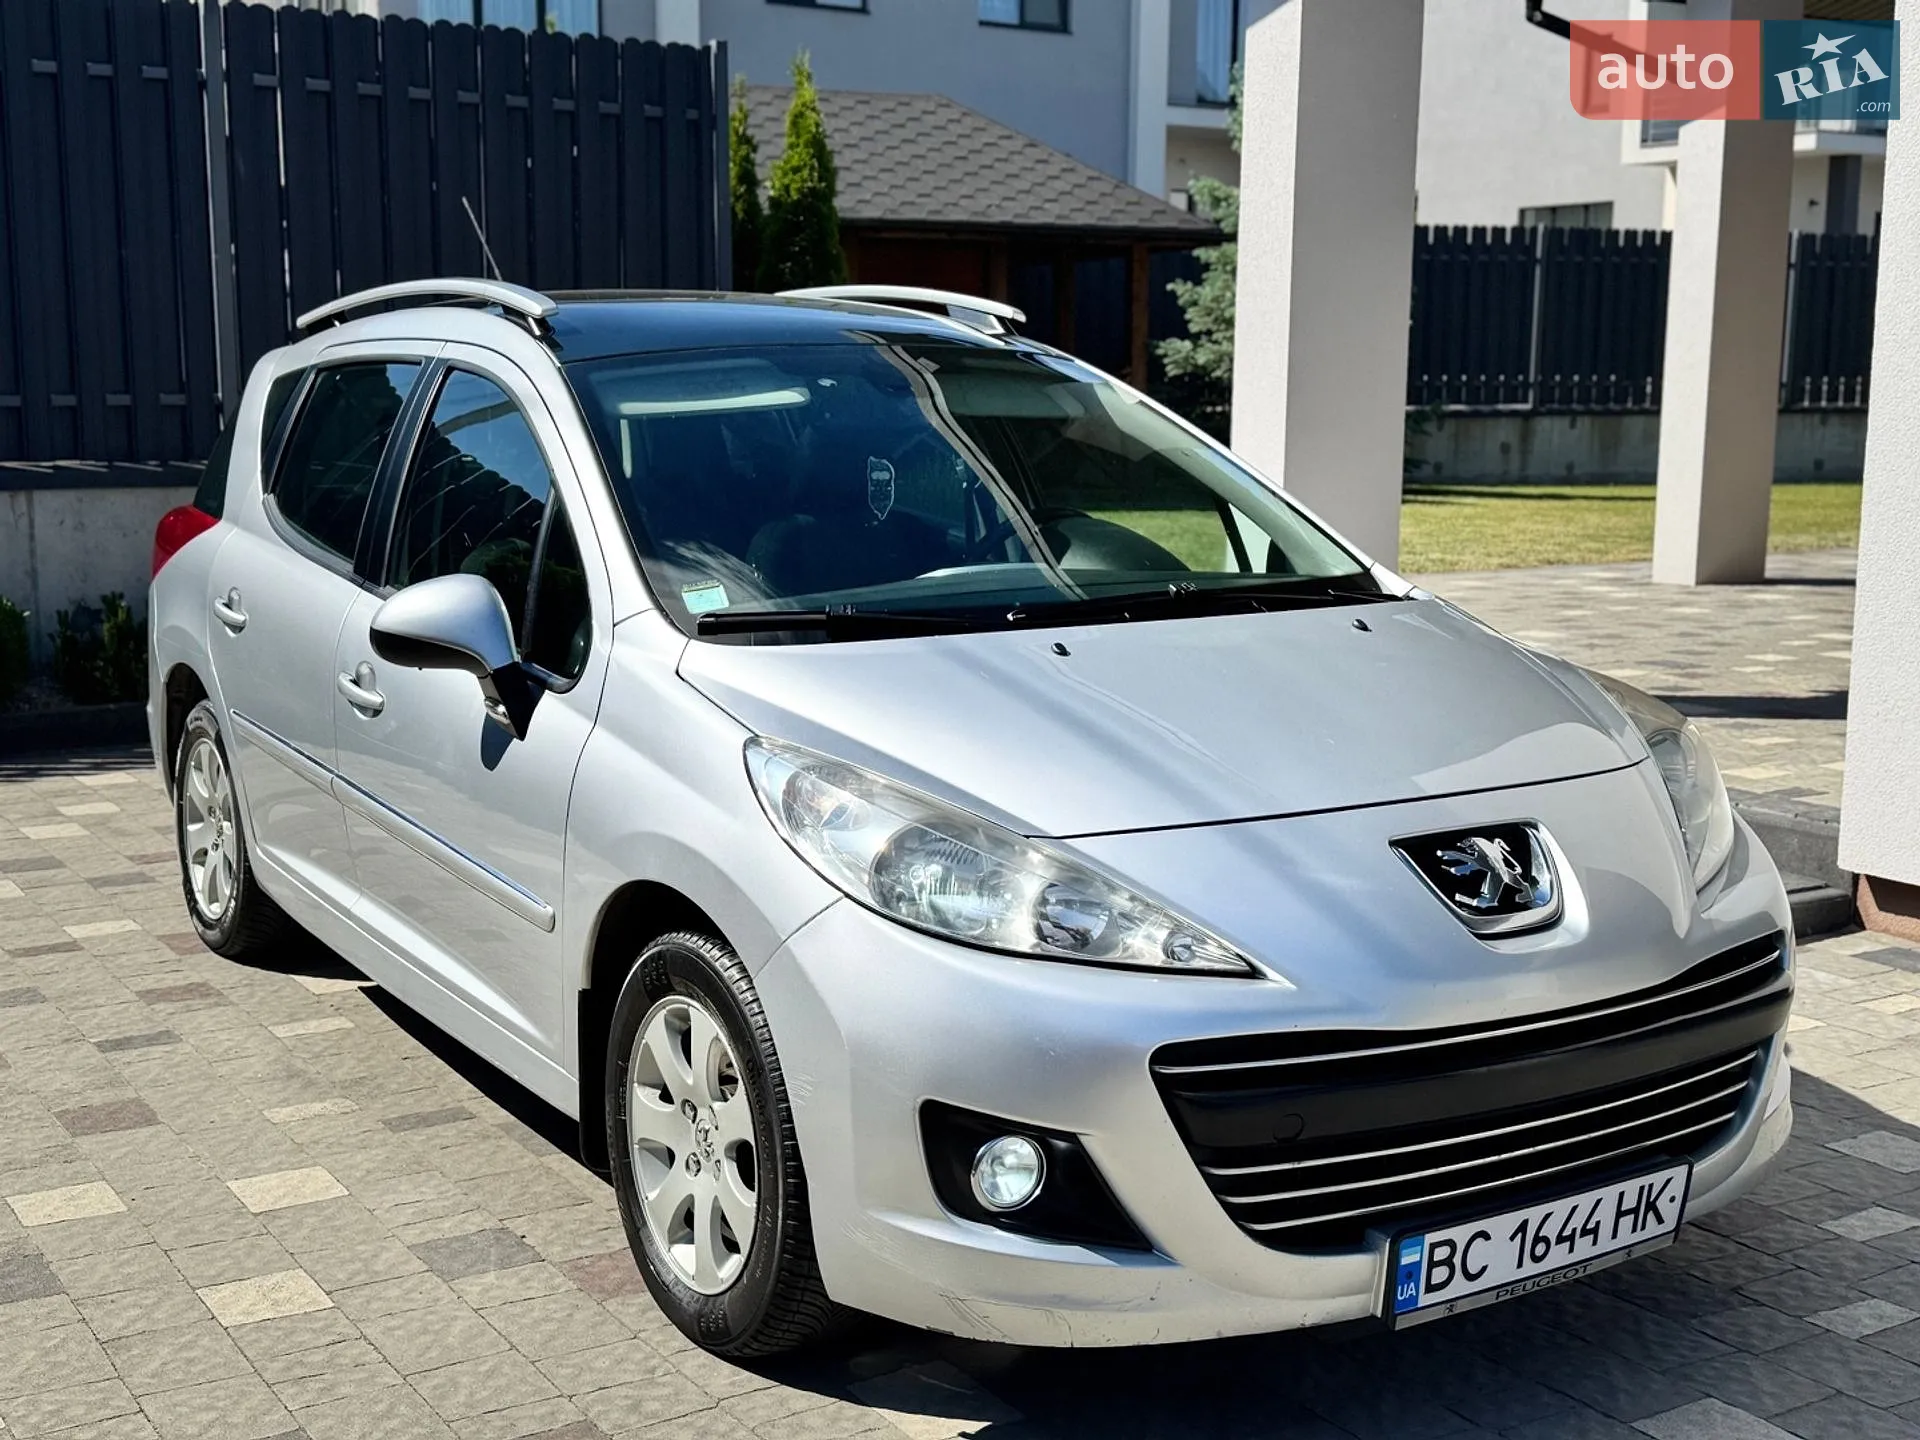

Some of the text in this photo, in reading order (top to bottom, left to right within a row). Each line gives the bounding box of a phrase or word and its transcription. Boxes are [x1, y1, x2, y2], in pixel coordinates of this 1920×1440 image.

[1424, 1176, 1674, 1295] BC 1644 HK
[1396, 1282, 1417, 1301] UA
[1495, 1262, 1594, 1301] PEUGEOT
